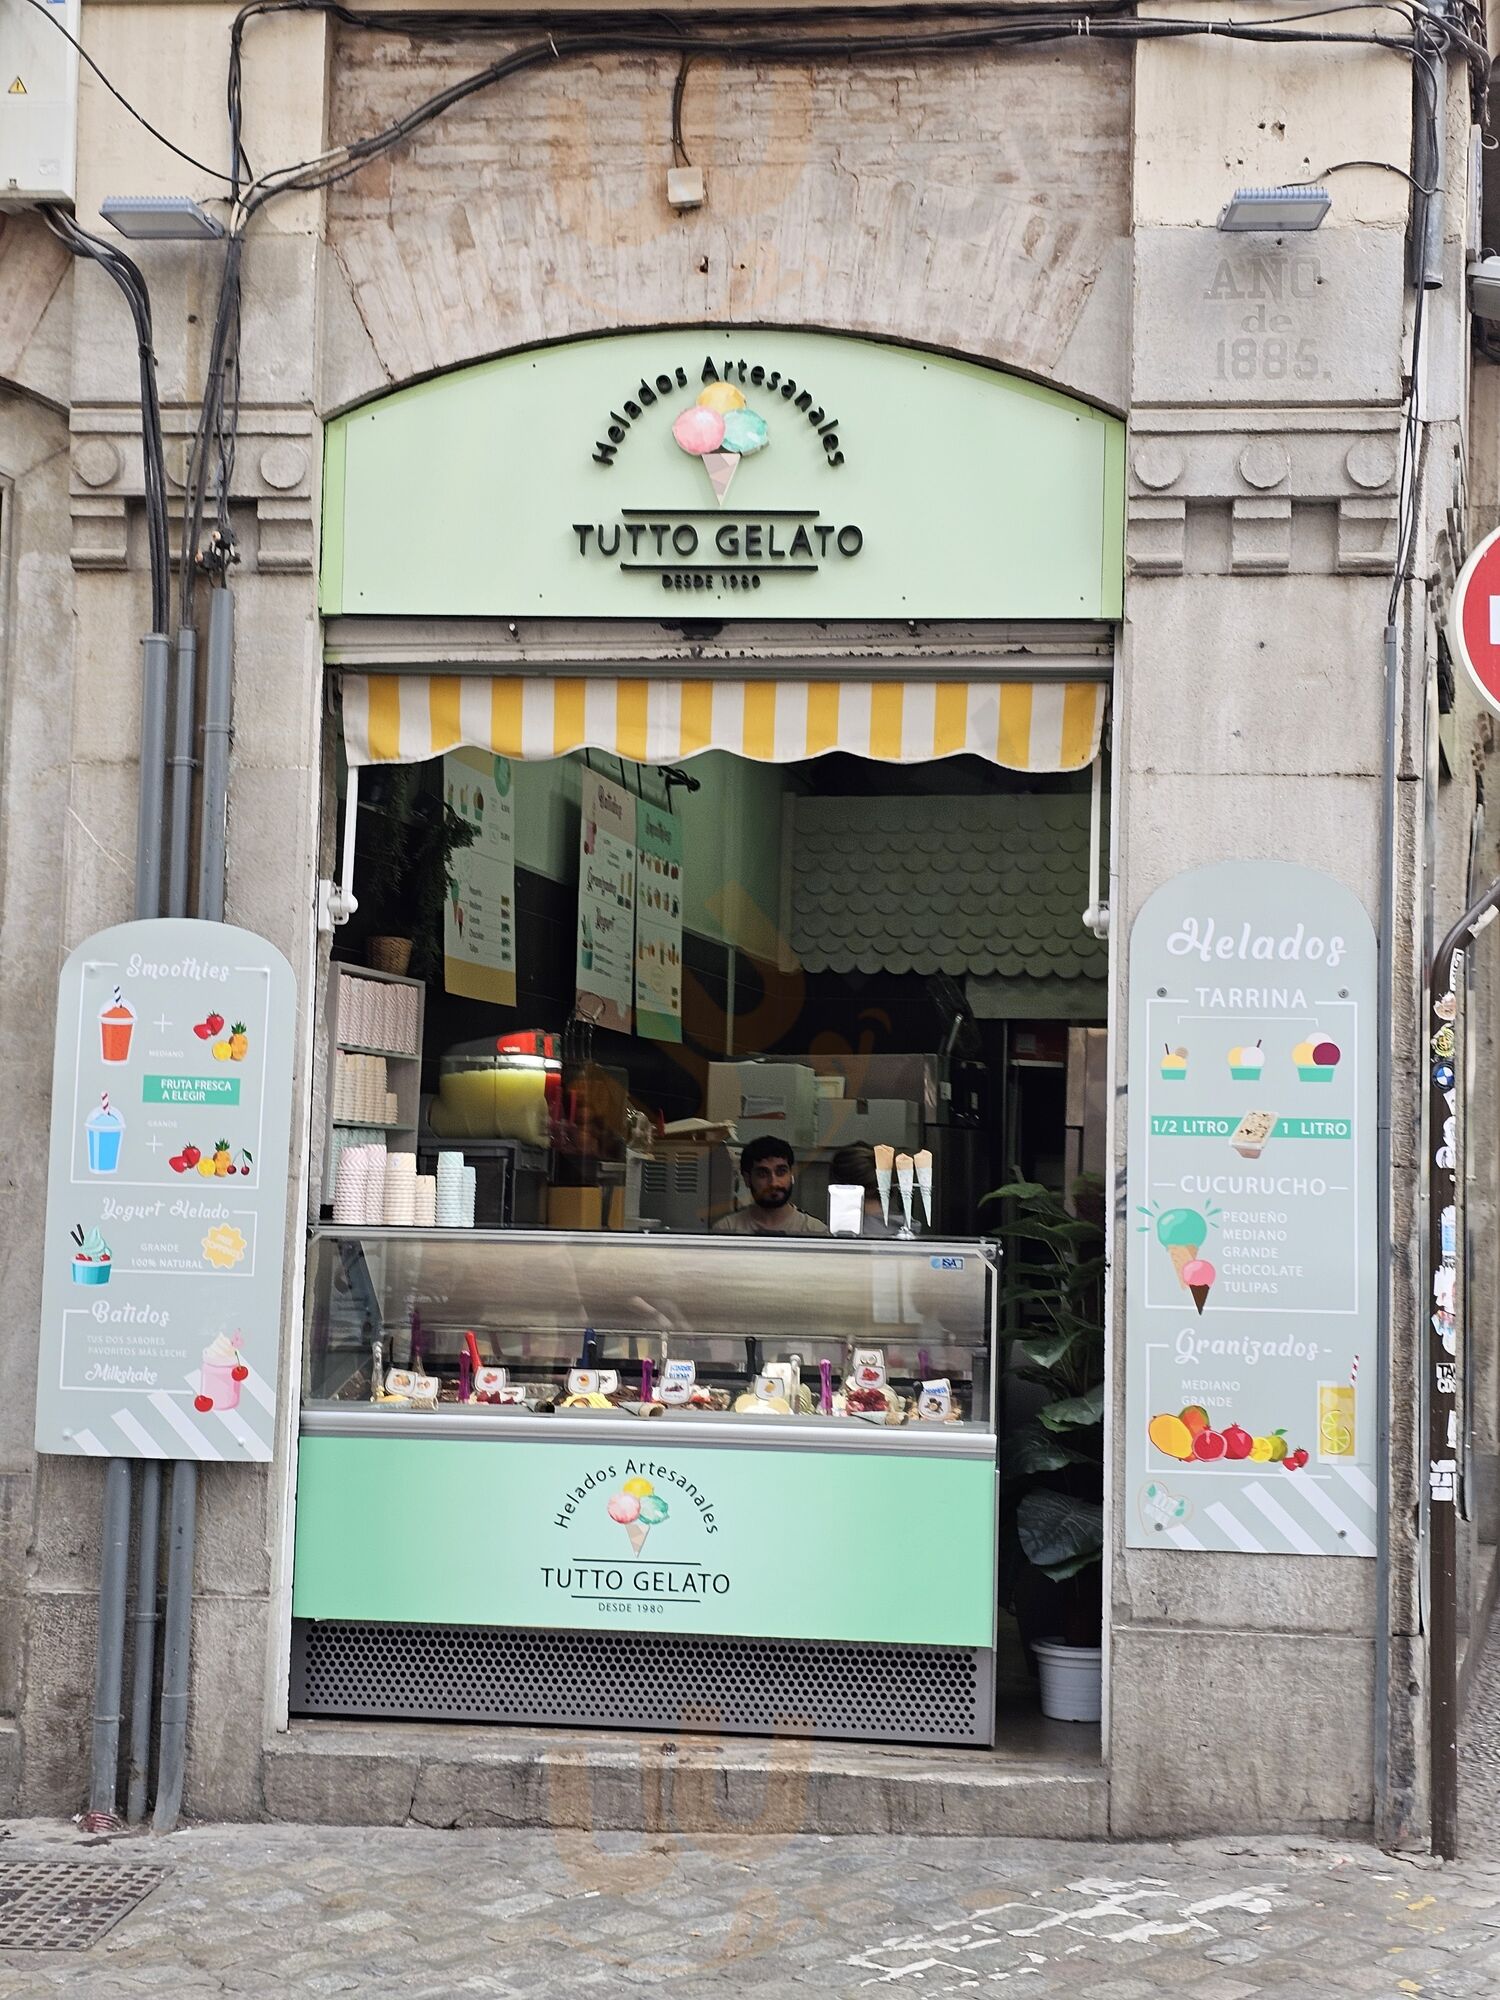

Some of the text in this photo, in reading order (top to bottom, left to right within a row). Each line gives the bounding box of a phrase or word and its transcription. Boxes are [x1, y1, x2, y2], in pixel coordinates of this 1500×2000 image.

[1240, 303, 1293, 333] de
[592, 356, 845, 467] Helados Artesanales
[572, 524, 864, 557] TUTTO GELATO
[661, 574, 761, 590] DESDE 1980
[1166, 917, 1348, 967] Helados
[126, 953, 232, 982] Smoothies
[1195, 987, 1309, 1009] TARRINA
[148, 1050, 185, 1059] MEDIANO
[160, 1078, 233, 1092] FRUTA FRESCA
[162, 1090, 206, 1102] A ELEGIR
[1153, 1119, 1229, 1135] 1/2 LITRO
[1281, 1122, 1348, 1136] 1 LITRO
[1180, 1175, 1327, 1196] CUCURUCHO
[100, 1197, 230, 1222] Yogurt Helado
[1222, 1210, 1288, 1225] PEQUEÑO
[1222, 1229, 1288, 1242] MEDIANO
[140, 1243, 180, 1252] GRANDE
[1222, 1246, 1280, 1259] GRANDE
[131, 1258, 204, 1269] 100% NATURAL
[1222, 1264, 1304, 1278] CHOCOLATE
[1223, 1281, 1279, 1295] TULIPAS
[91, 1300, 170, 1327] Batidos
[87, 1335, 166, 1346] TUS DOS SABORES
[1174, 1328, 1320, 1365] Granizados
[88, 1346, 137, 1356] FAVORITOS
[159, 1348, 188, 1358] LECHE
[85, 1363, 158, 1385] Milkshake
[1181, 1379, 1241, 1392] MEDIANO
[1181, 1395, 1233, 1408] GRANDE
[554, 1459, 719, 1534] Helados Artesanales
[540, 1567, 730, 1594] TUTTO GELATO
[598, 1602, 664, 1614] DESDE 1980
